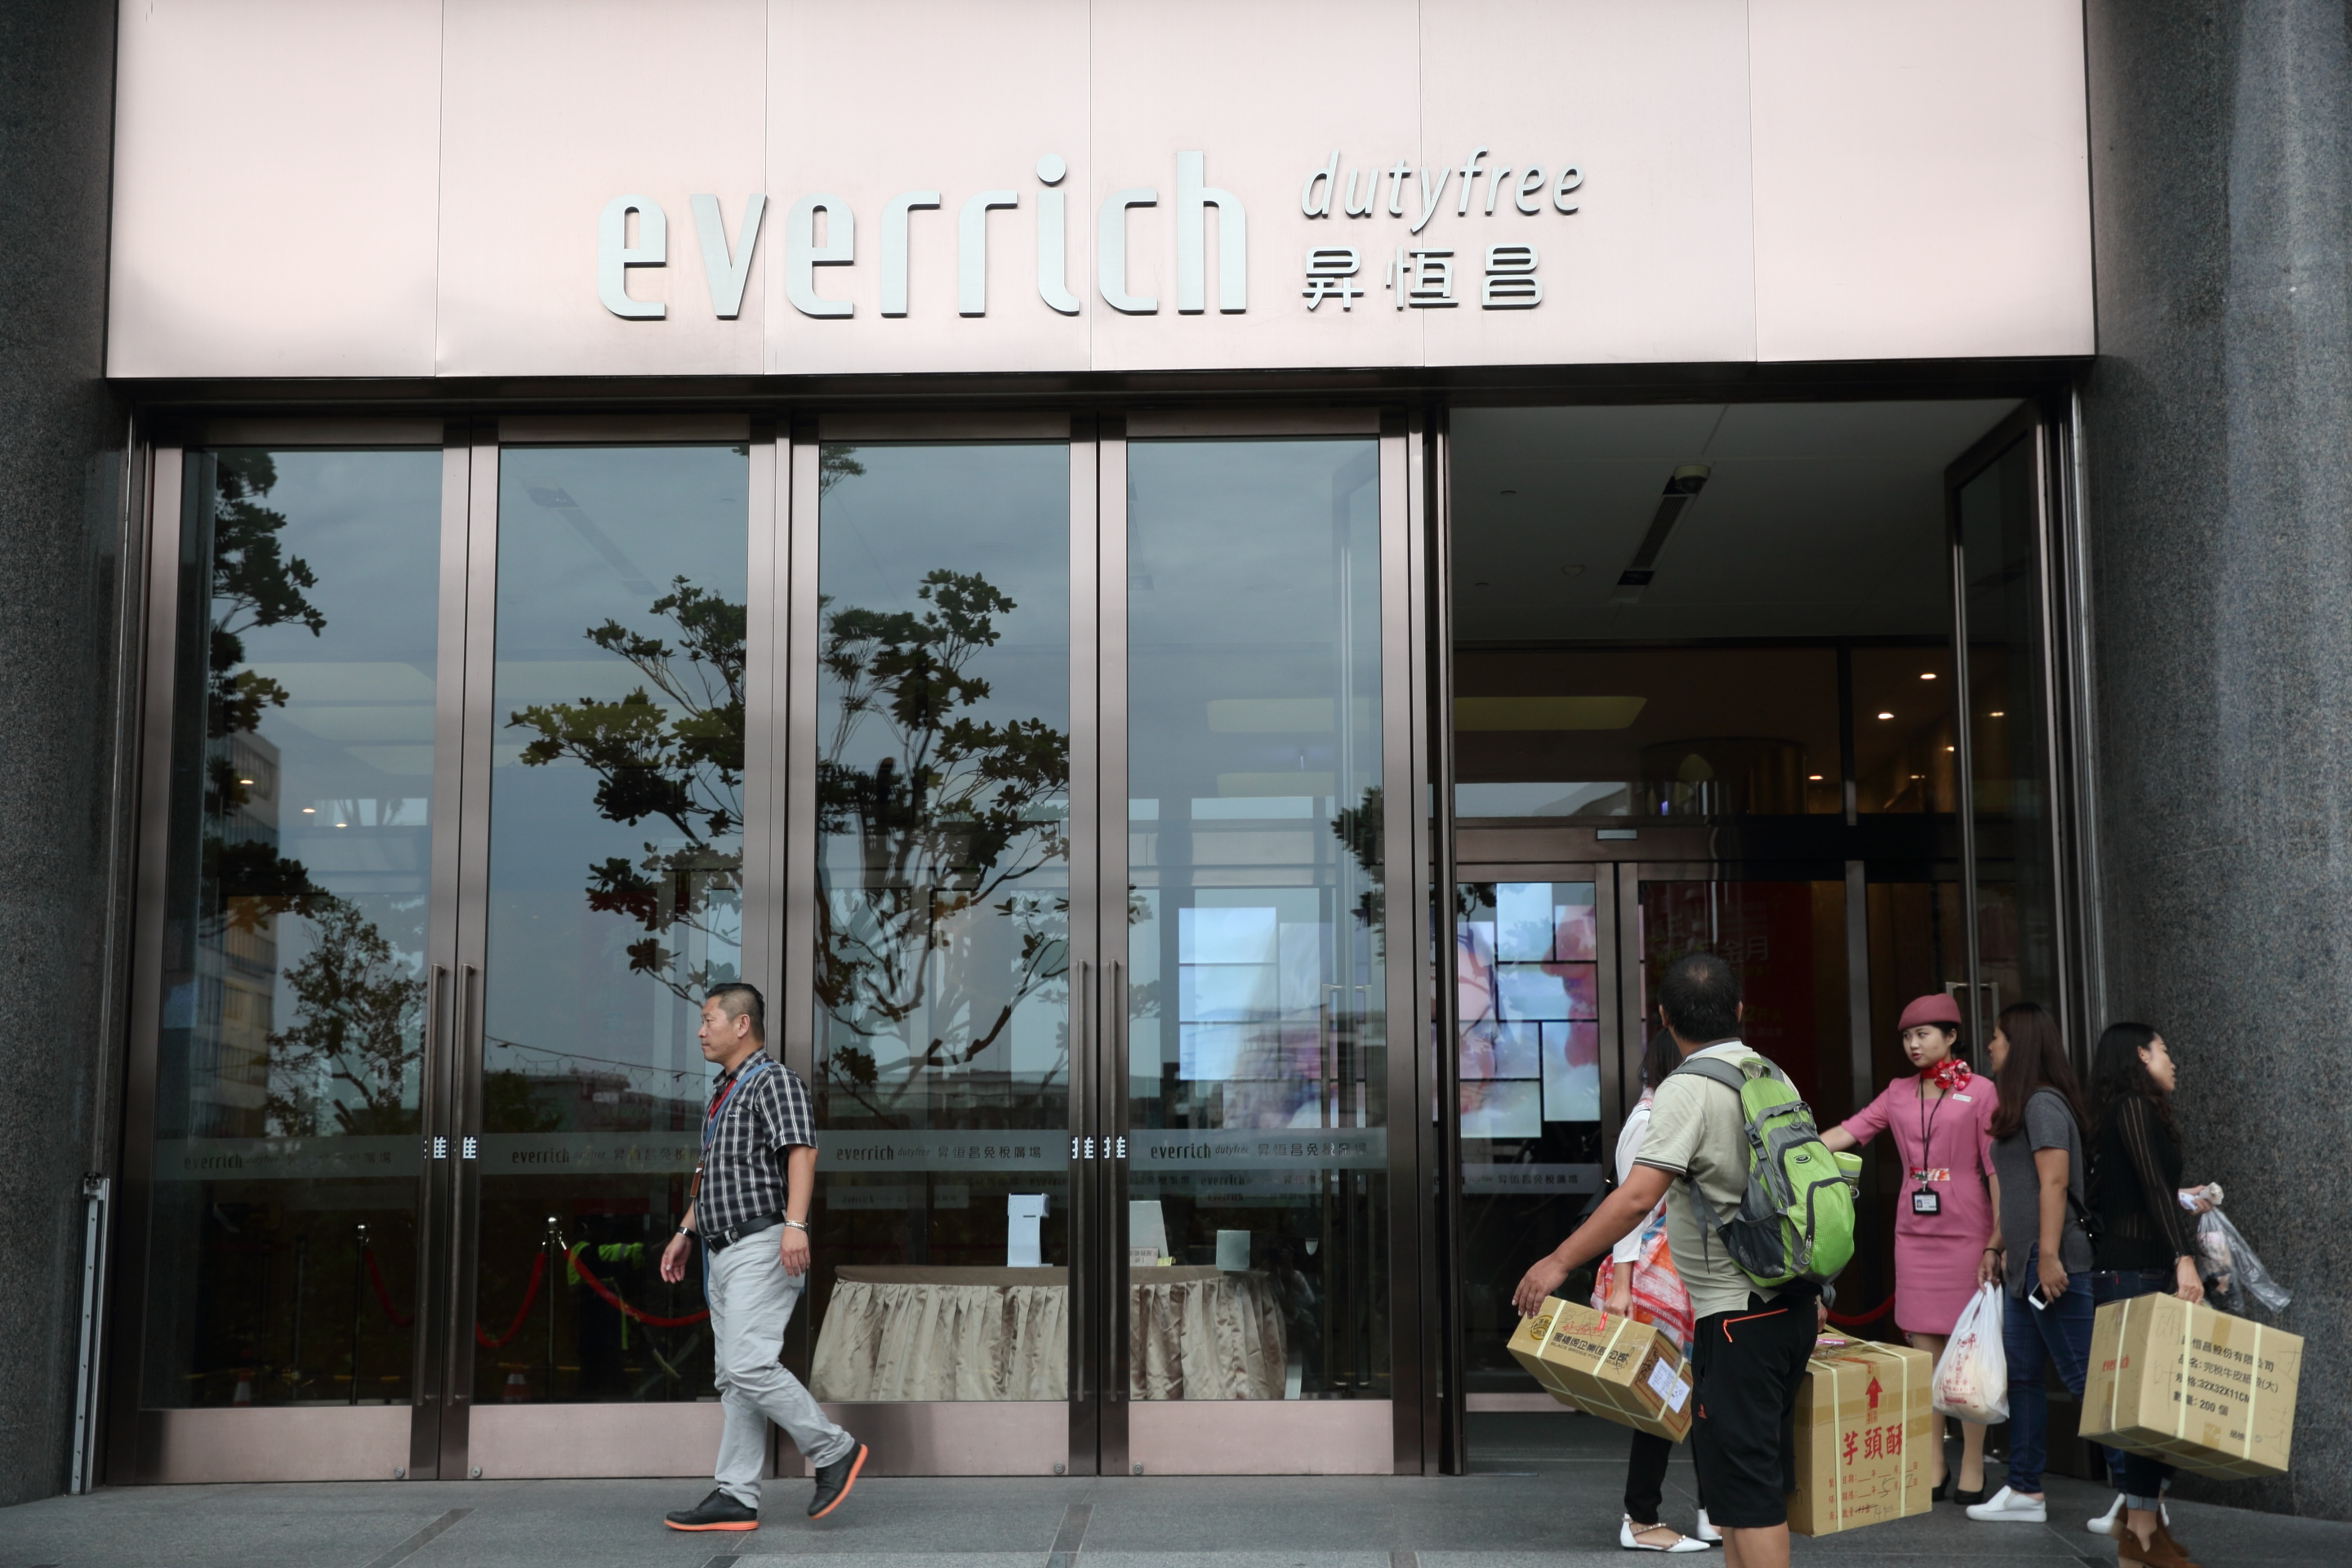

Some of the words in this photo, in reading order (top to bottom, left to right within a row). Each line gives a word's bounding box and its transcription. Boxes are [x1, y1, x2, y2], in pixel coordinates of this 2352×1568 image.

[1301, 147, 1585, 234] dutyfree
[598, 151, 1247, 321] everrich
[1301, 242, 1542, 311] 昇恒昌
[512, 1147, 570, 1164] everrich
[836, 1145, 893, 1160] everrich
[898, 1147, 930, 1158] dutyfree
[1072, 1136, 1094, 1159] 推
[1104, 1136, 1126, 1159] 推
[1151, 1143, 1212, 1159] everrich
[1215, 1144, 1250, 1156] dutyfree
[184, 1153, 243, 1169] everrich
[2199, 1400, 2216, 1412] 200
[1842, 1423, 1903, 1466] 芋頭酥
